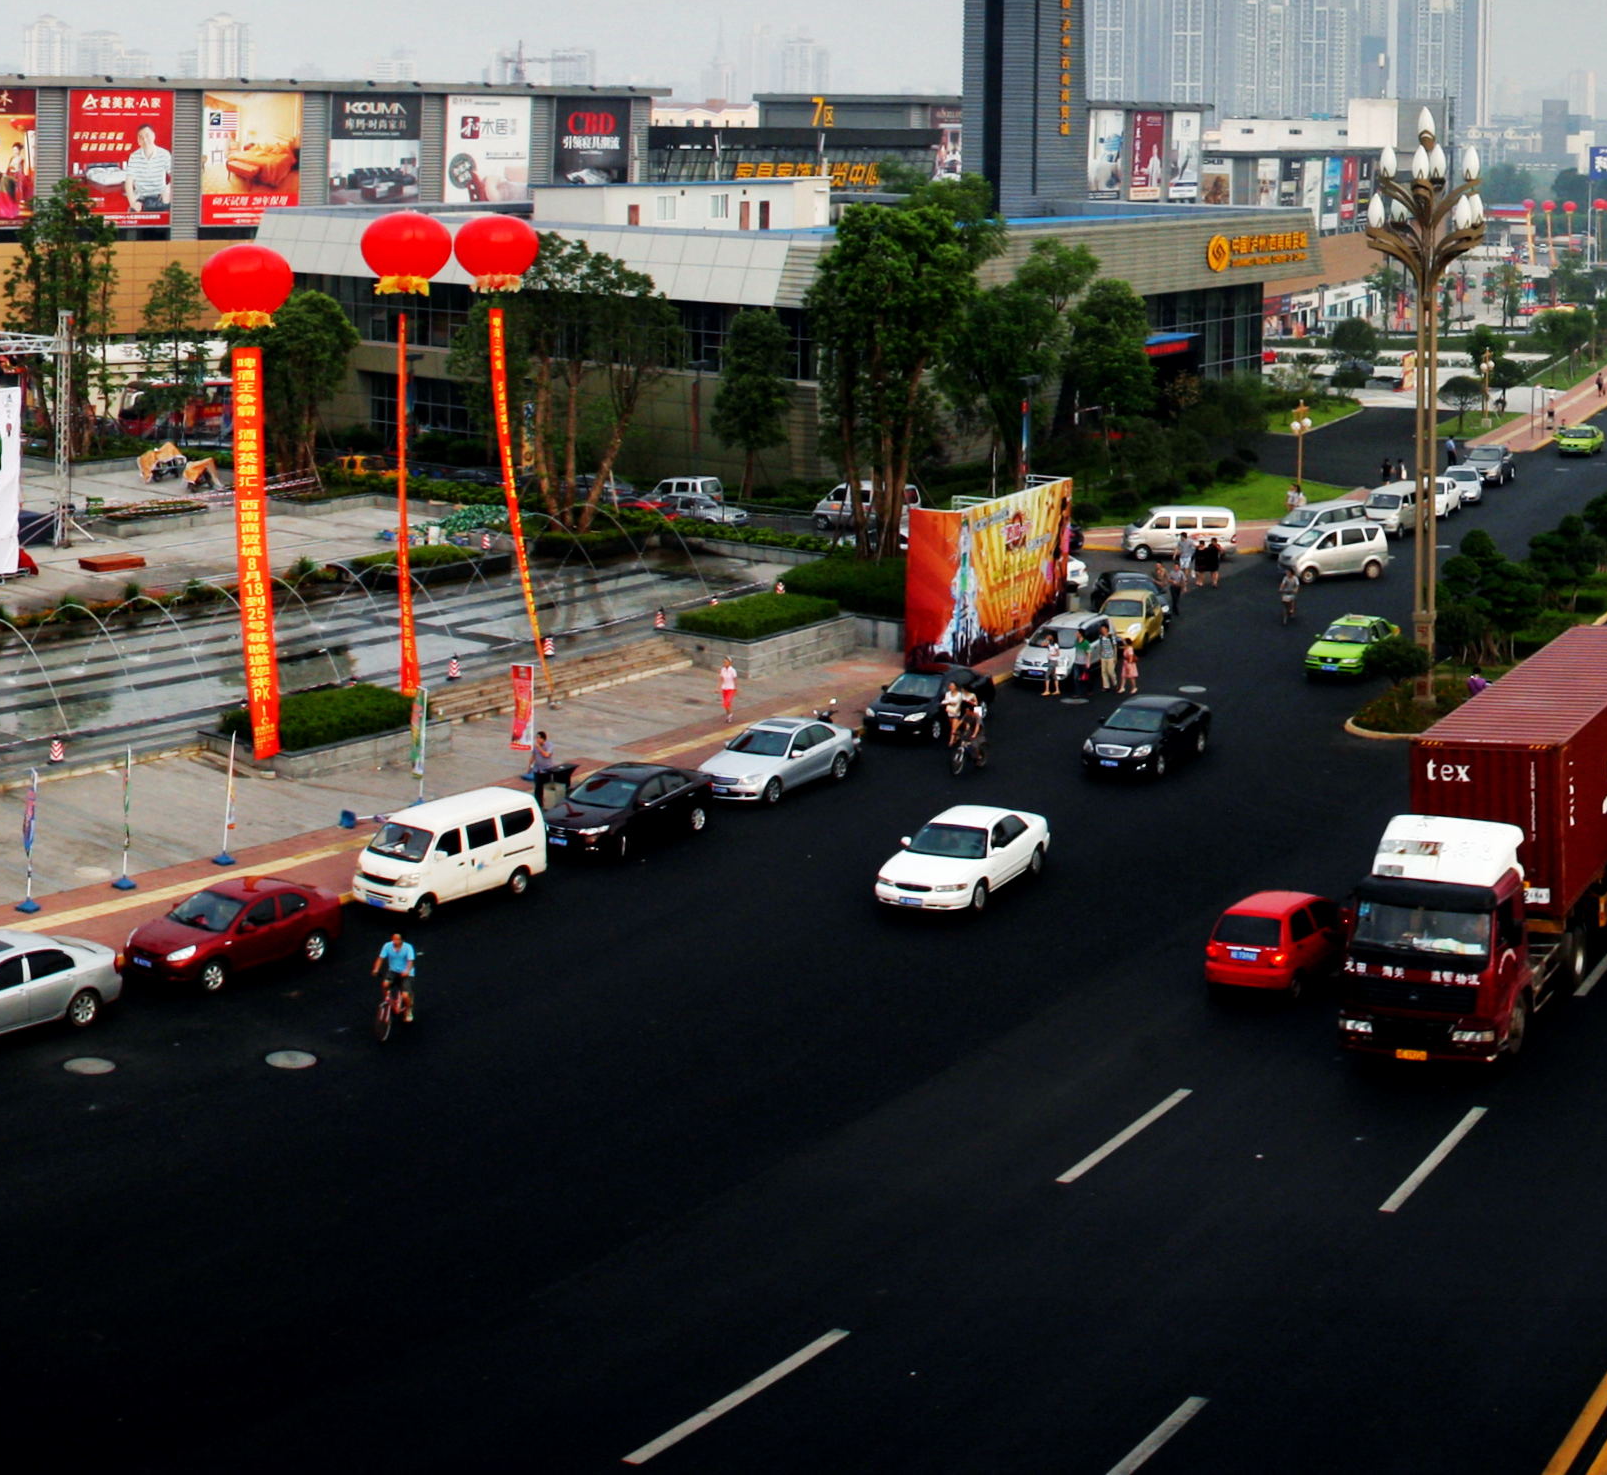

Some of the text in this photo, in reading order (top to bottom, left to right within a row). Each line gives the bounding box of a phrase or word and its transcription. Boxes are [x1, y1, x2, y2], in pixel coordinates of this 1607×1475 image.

[567, 110, 616, 136] CBD
[810, 97, 834, 127] 7区
[562, 135, 621, 151] 引领寝具潮流
[1426, 758, 1471, 783] tex
